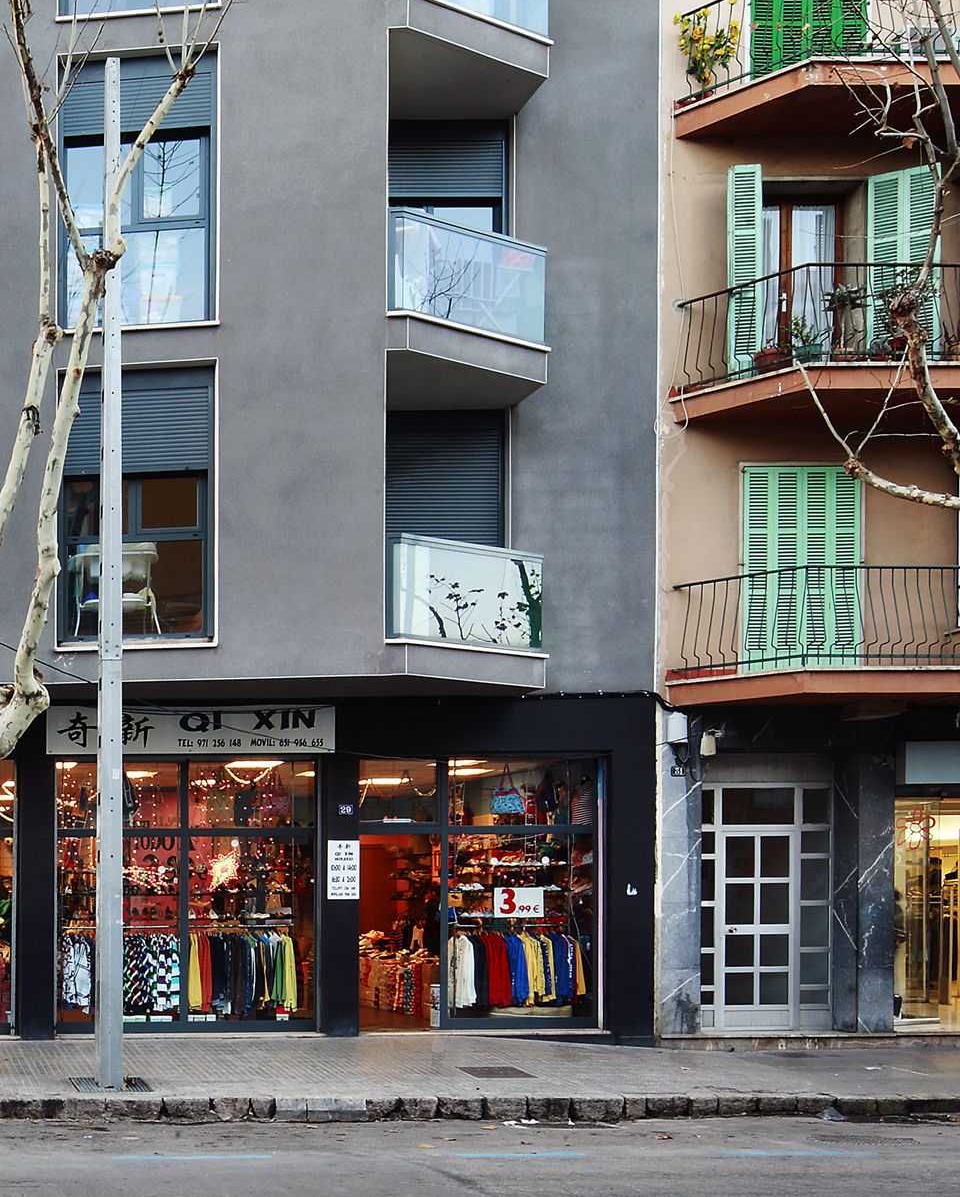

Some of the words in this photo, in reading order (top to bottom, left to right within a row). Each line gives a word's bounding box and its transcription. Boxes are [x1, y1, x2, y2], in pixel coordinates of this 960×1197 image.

[179, 710, 222, 733] QI
[252, 709, 316, 731] XIN
[177, 738, 193, 748] TEL:
[197, 738, 209, 748] 971
[212, 738, 225, 748] 256
[229, 738, 242, 748] 148
[250, 738, 276, 748] MOVIL:
[294, 738, 307, 748] 956
[311, 738, 324, 748] 655
[674, 767, 683, 775] 31
